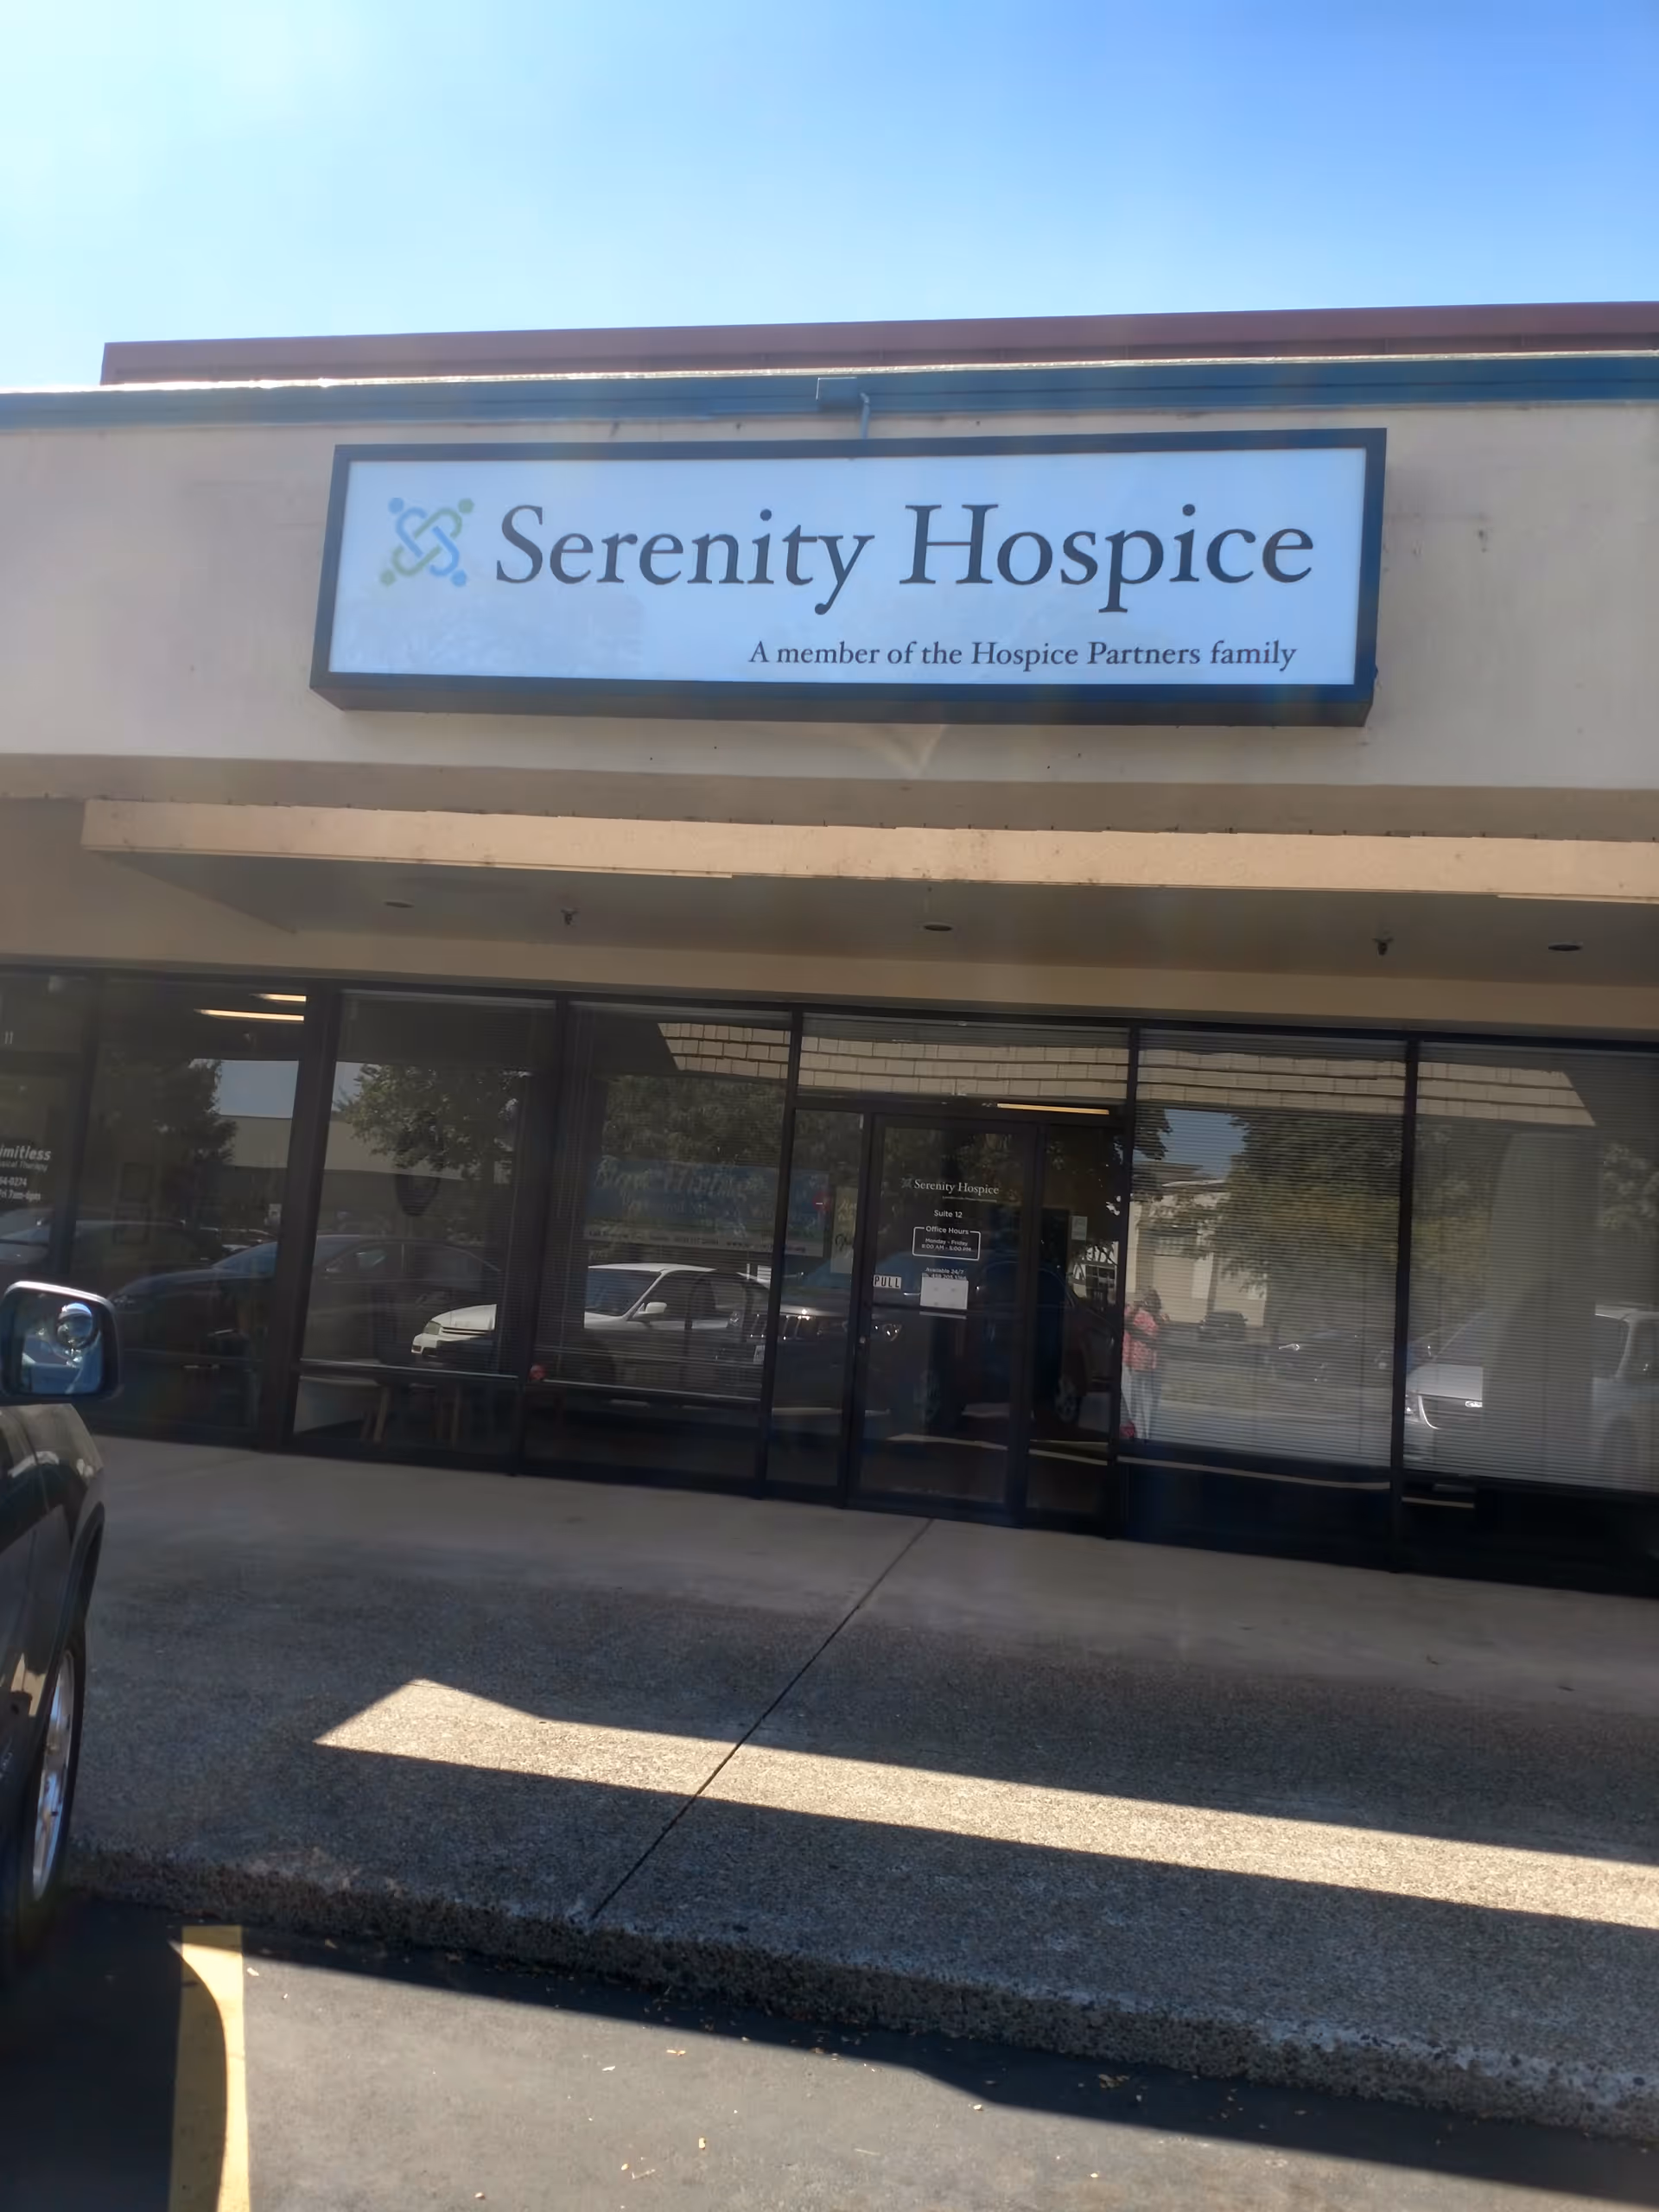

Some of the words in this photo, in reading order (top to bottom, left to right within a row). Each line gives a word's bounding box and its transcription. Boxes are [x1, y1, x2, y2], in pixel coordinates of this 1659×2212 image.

[496, 505, 874, 615] Serenity
[899, 503, 1313, 613] Hospice
[748, 641, 768, 663] A
[777, 641, 880, 664] member
[887, 641, 917, 664] of
[922, 641, 962, 664] the
[971, 641, 1078, 671] Hospice
[1087, 641, 1201, 664] Partners
[1210, 640, 1298, 671] family
[0, 1142, 52, 1160] imitless
[914, 1179, 956, 1194] Serenity
[958, 1182, 999, 1196] Hospice
[874, 1275, 899, 1288] PULL
